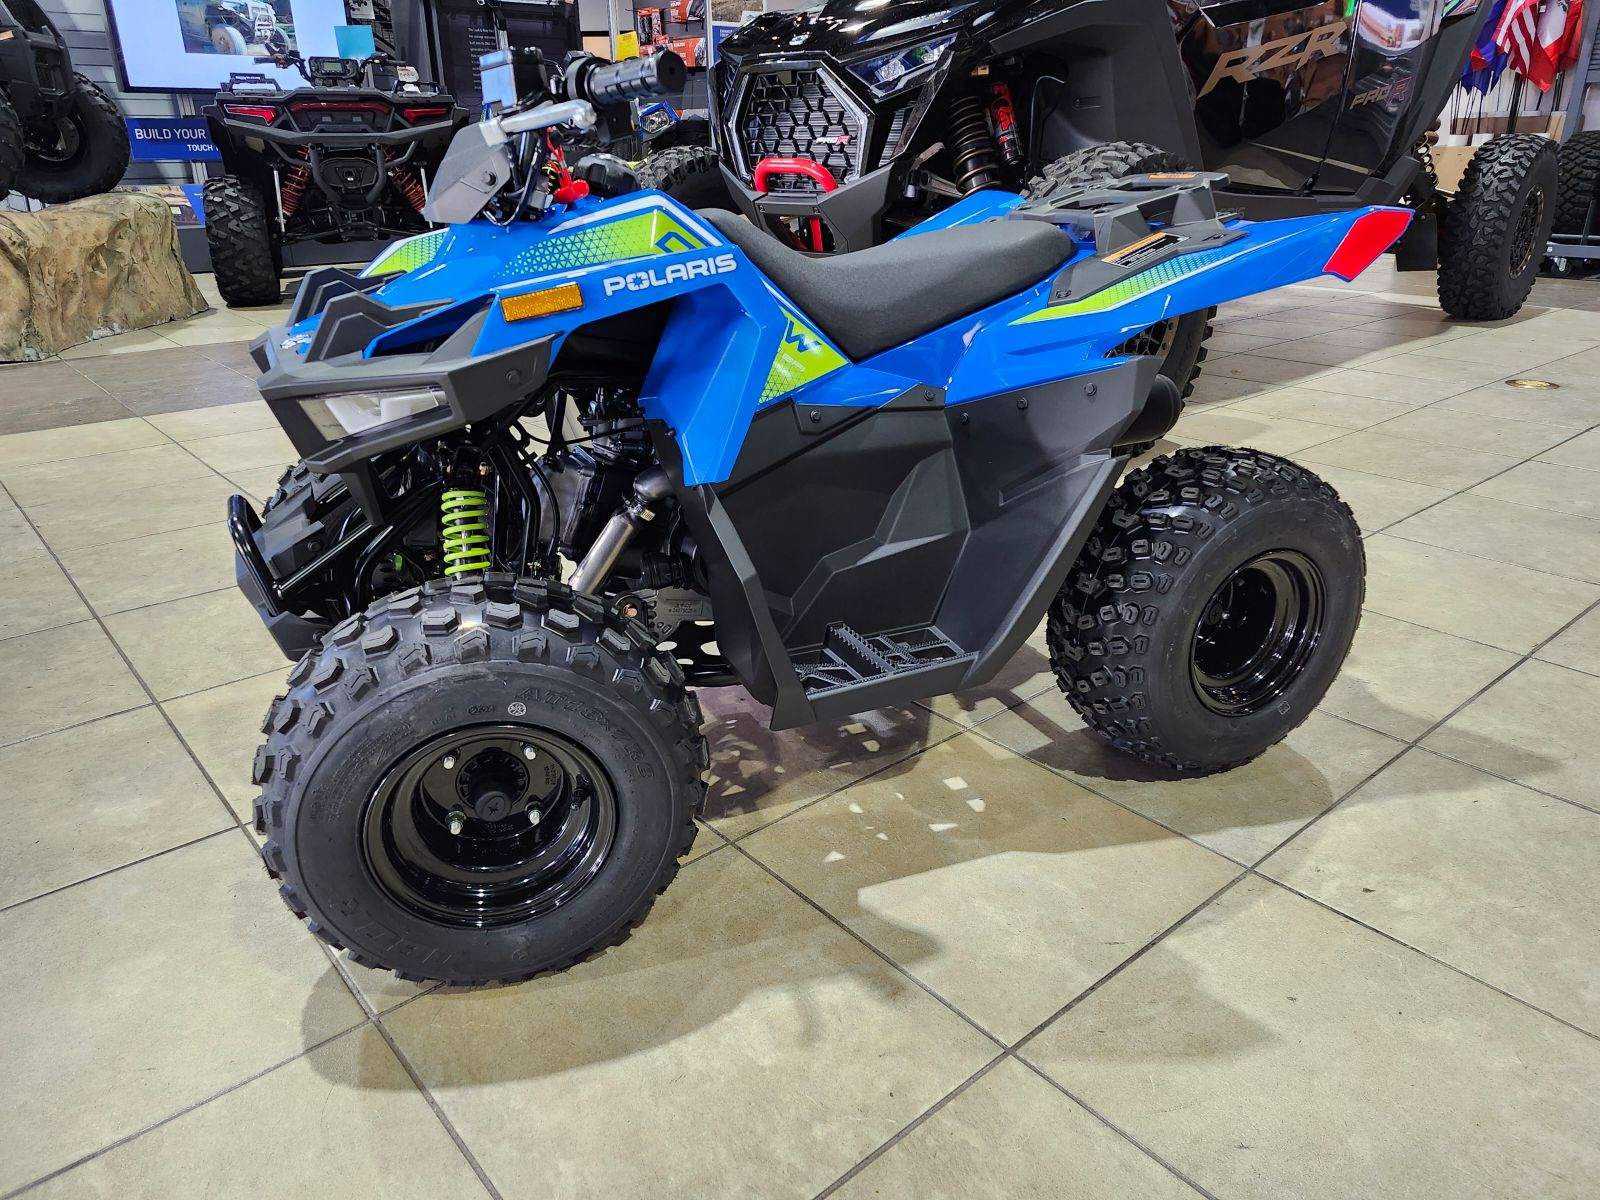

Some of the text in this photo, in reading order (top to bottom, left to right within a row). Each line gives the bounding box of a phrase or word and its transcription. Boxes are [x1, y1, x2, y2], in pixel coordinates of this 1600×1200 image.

[1196, 21, 1347, 100] RZR
[134, 128, 206, 139] BUILD YOUR
[603, 253, 737, 296] POLARIS
